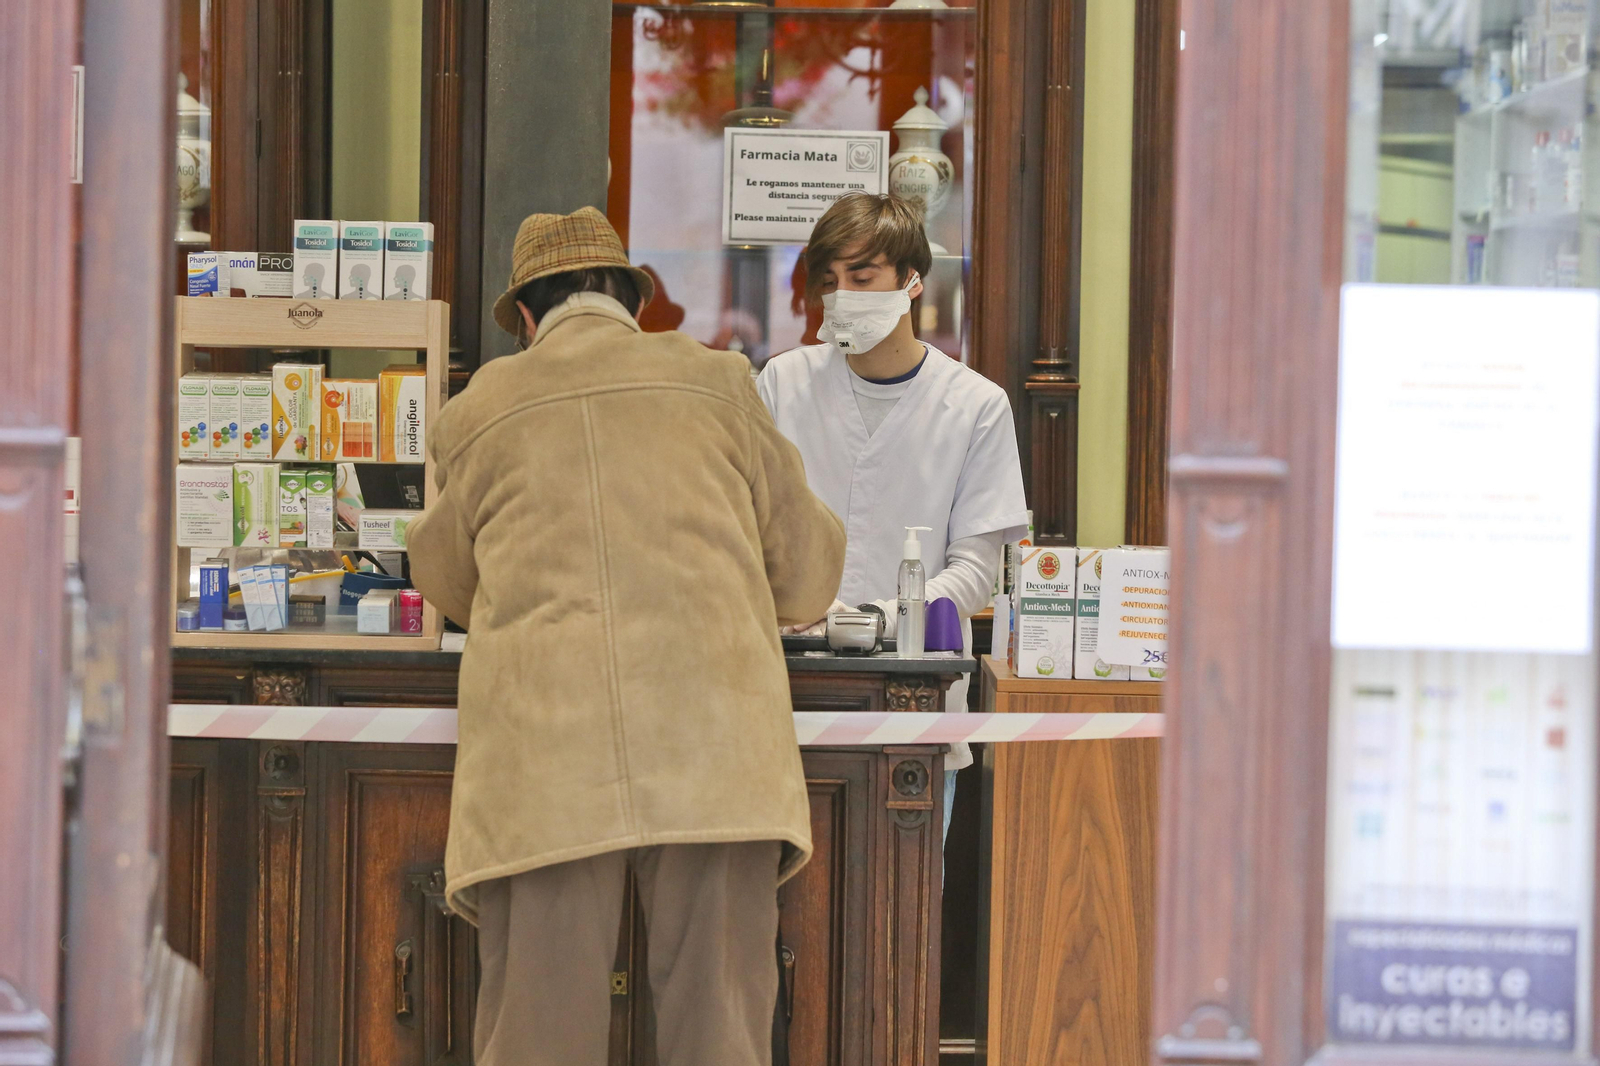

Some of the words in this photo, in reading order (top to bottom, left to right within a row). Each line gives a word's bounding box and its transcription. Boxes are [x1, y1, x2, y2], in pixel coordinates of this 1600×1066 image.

[740, 149, 800, 161] Farmacia
[804, 151, 838, 162] Mata
[899, 166, 925, 178] RAIZ
[760, 180, 799, 189] rogamos
[801, 181, 845, 189] mantener
[768, 191, 809, 200] distancia
[812, 192, 836, 201] segur
[734, 213, 764, 221] Please
[766, 214, 807, 223] maintain
[304, 238, 327, 246] Tosidol
[350, 239, 373, 247] Tosidol
[395, 240, 418, 248] Tosidol
[189, 255, 217, 265] Pharysol
[260, 257, 293, 270] PRO
[287, 308, 324, 318] Juanola
[407, 399, 420, 455] angileptol
[180, 480, 229, 488] Bronchostop
[281, 505, 298, 513] TOS
[363, 520, 390, 529] Tusheel
[1026, 581, 1069, 591] Decottopia
[1122, 586, 1168, 596] -DEPURACIO
[1023, 602, 1071, 612] Antiox-Mech
[1380, 962, 1494, 997] curas
